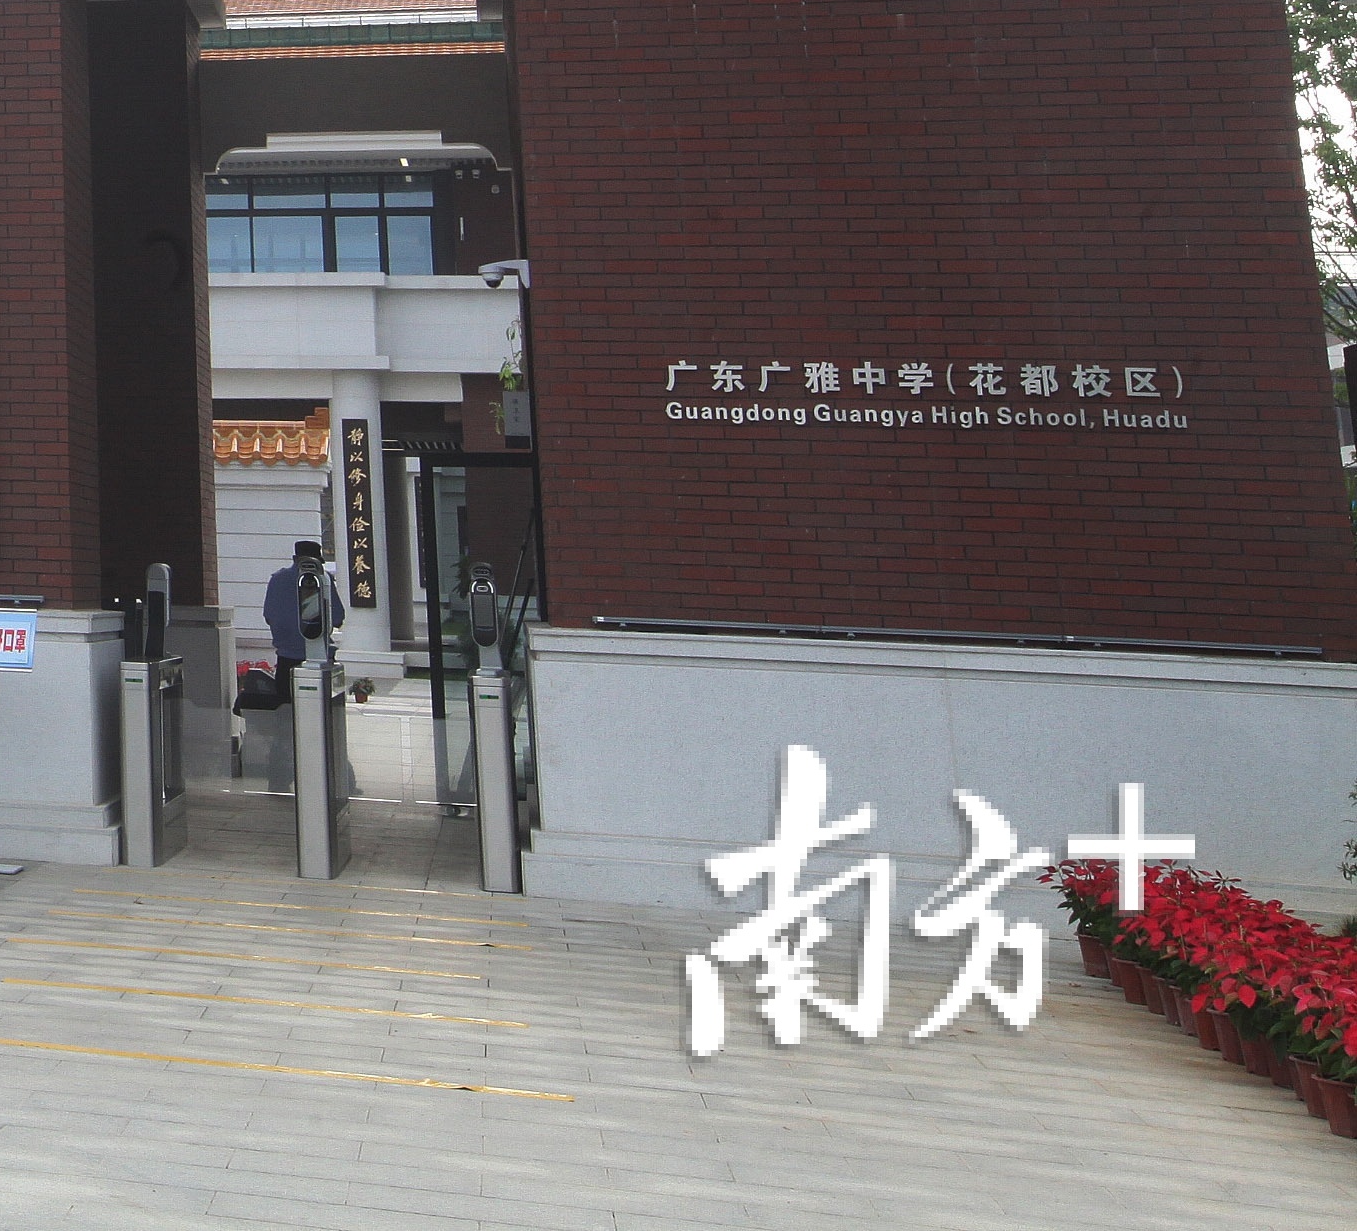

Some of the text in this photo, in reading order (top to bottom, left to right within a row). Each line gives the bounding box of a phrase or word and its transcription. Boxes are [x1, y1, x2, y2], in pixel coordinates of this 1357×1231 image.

[665, 401, 1188, 430] Guangdong Guangya High School, Huadu
